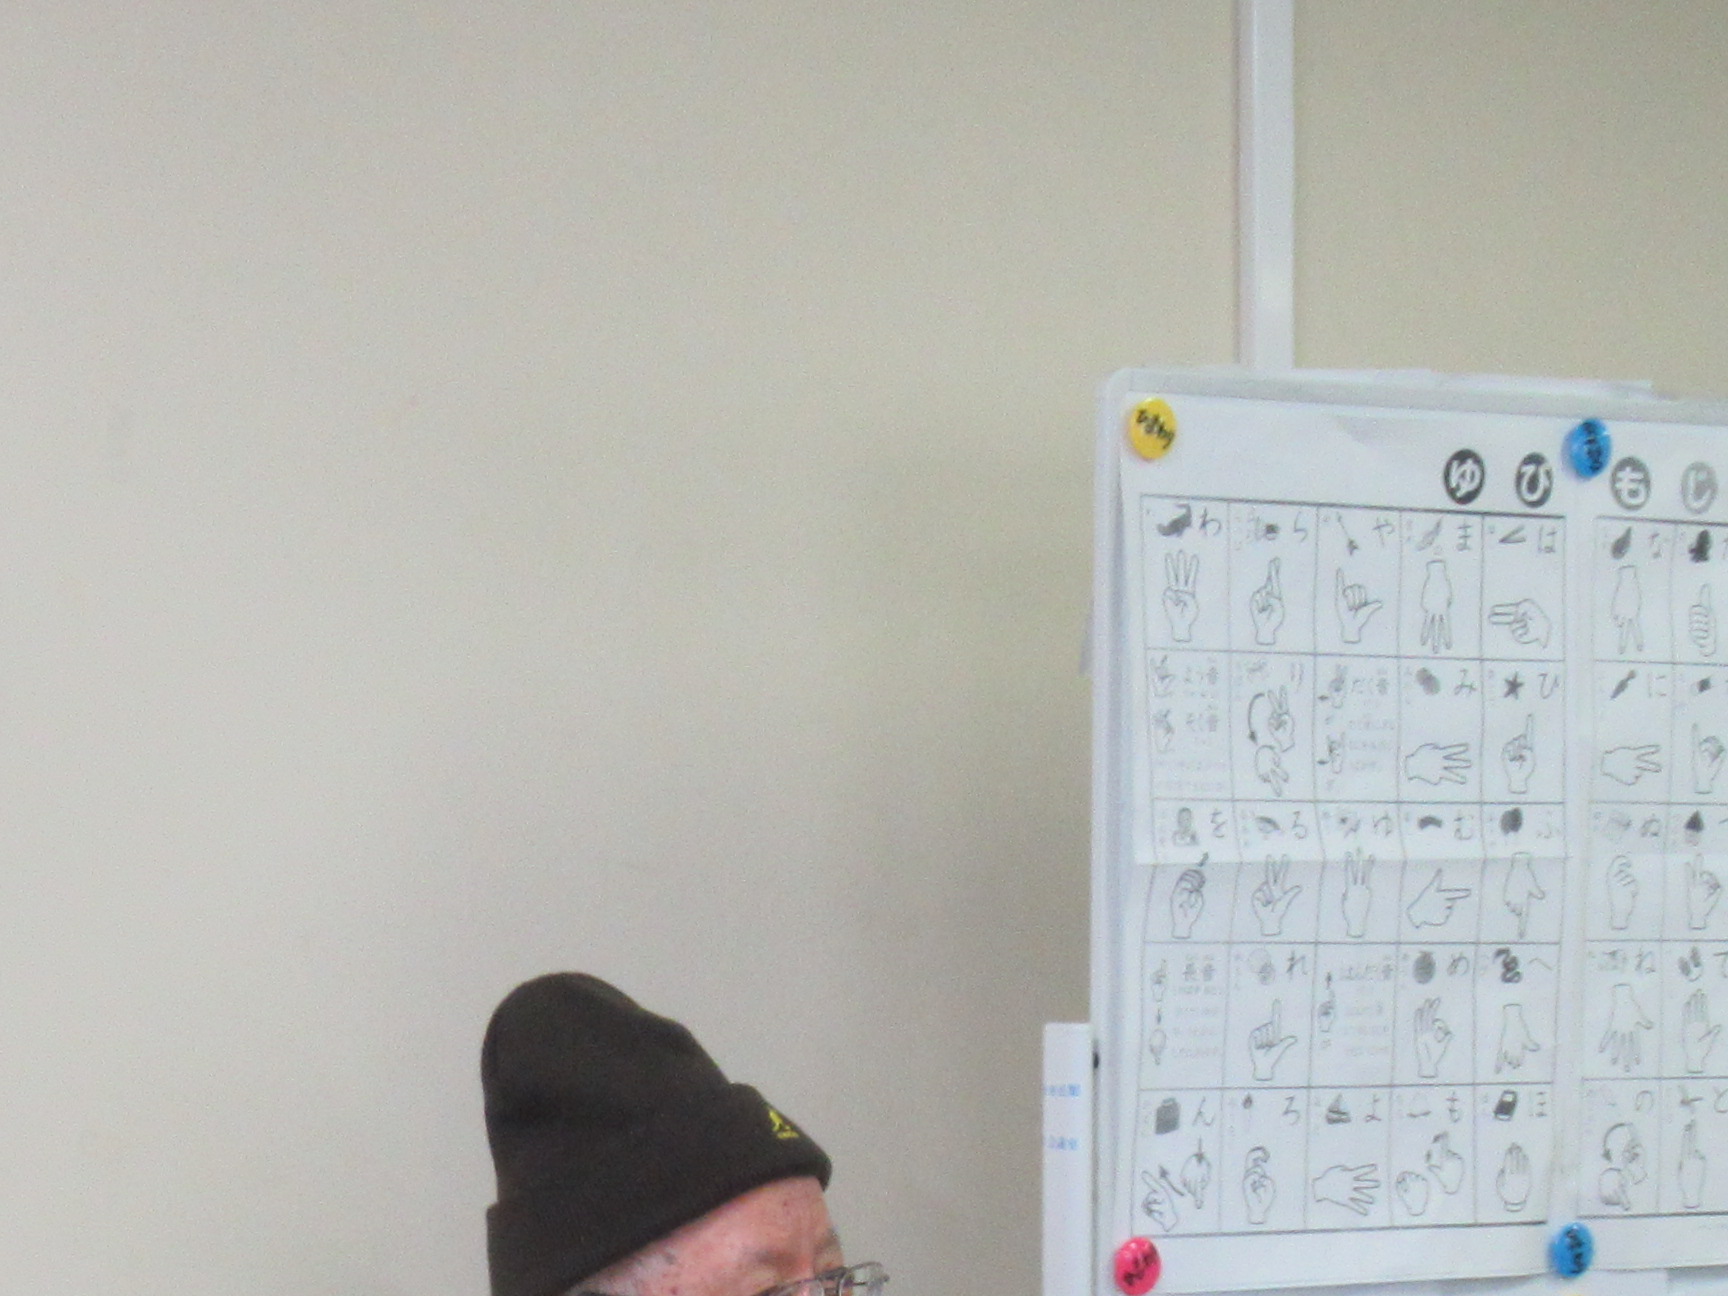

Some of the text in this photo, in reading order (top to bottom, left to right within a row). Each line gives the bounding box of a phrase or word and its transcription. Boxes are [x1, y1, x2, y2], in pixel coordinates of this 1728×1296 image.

[1200, 507, 1221, 536] わ
[1294, 511, 1308, 542] ら
[1372, 517, 1395, 547] や
[1456, 519, 1471, 551] ま
[1538, 524, 1559, 554] は
[1290, 661, 1304, 694] り
[1454, 667, 1477, 696] み
[1538, 672, 1561, 700] ひ
[1646, 671, 1668, 698] に
[1209, 807, 1228, 839] を
[1292, 810, 1308, 840] る
[1454, 810, 1474, 841] む
[1286, 950, 1309, 981] れ
[1447, 951, 1470, 978] め
[1528, 957, 1553, 972] へ
[1192, 1096, 1215, 1127] ん
[1282, 1095, 1302, 1127] ろ
[1365, 1093, 1383, 1122] よ
[1445, 1090, 1462, 1124] も
[1634, 1089, 1655, 1113] の
